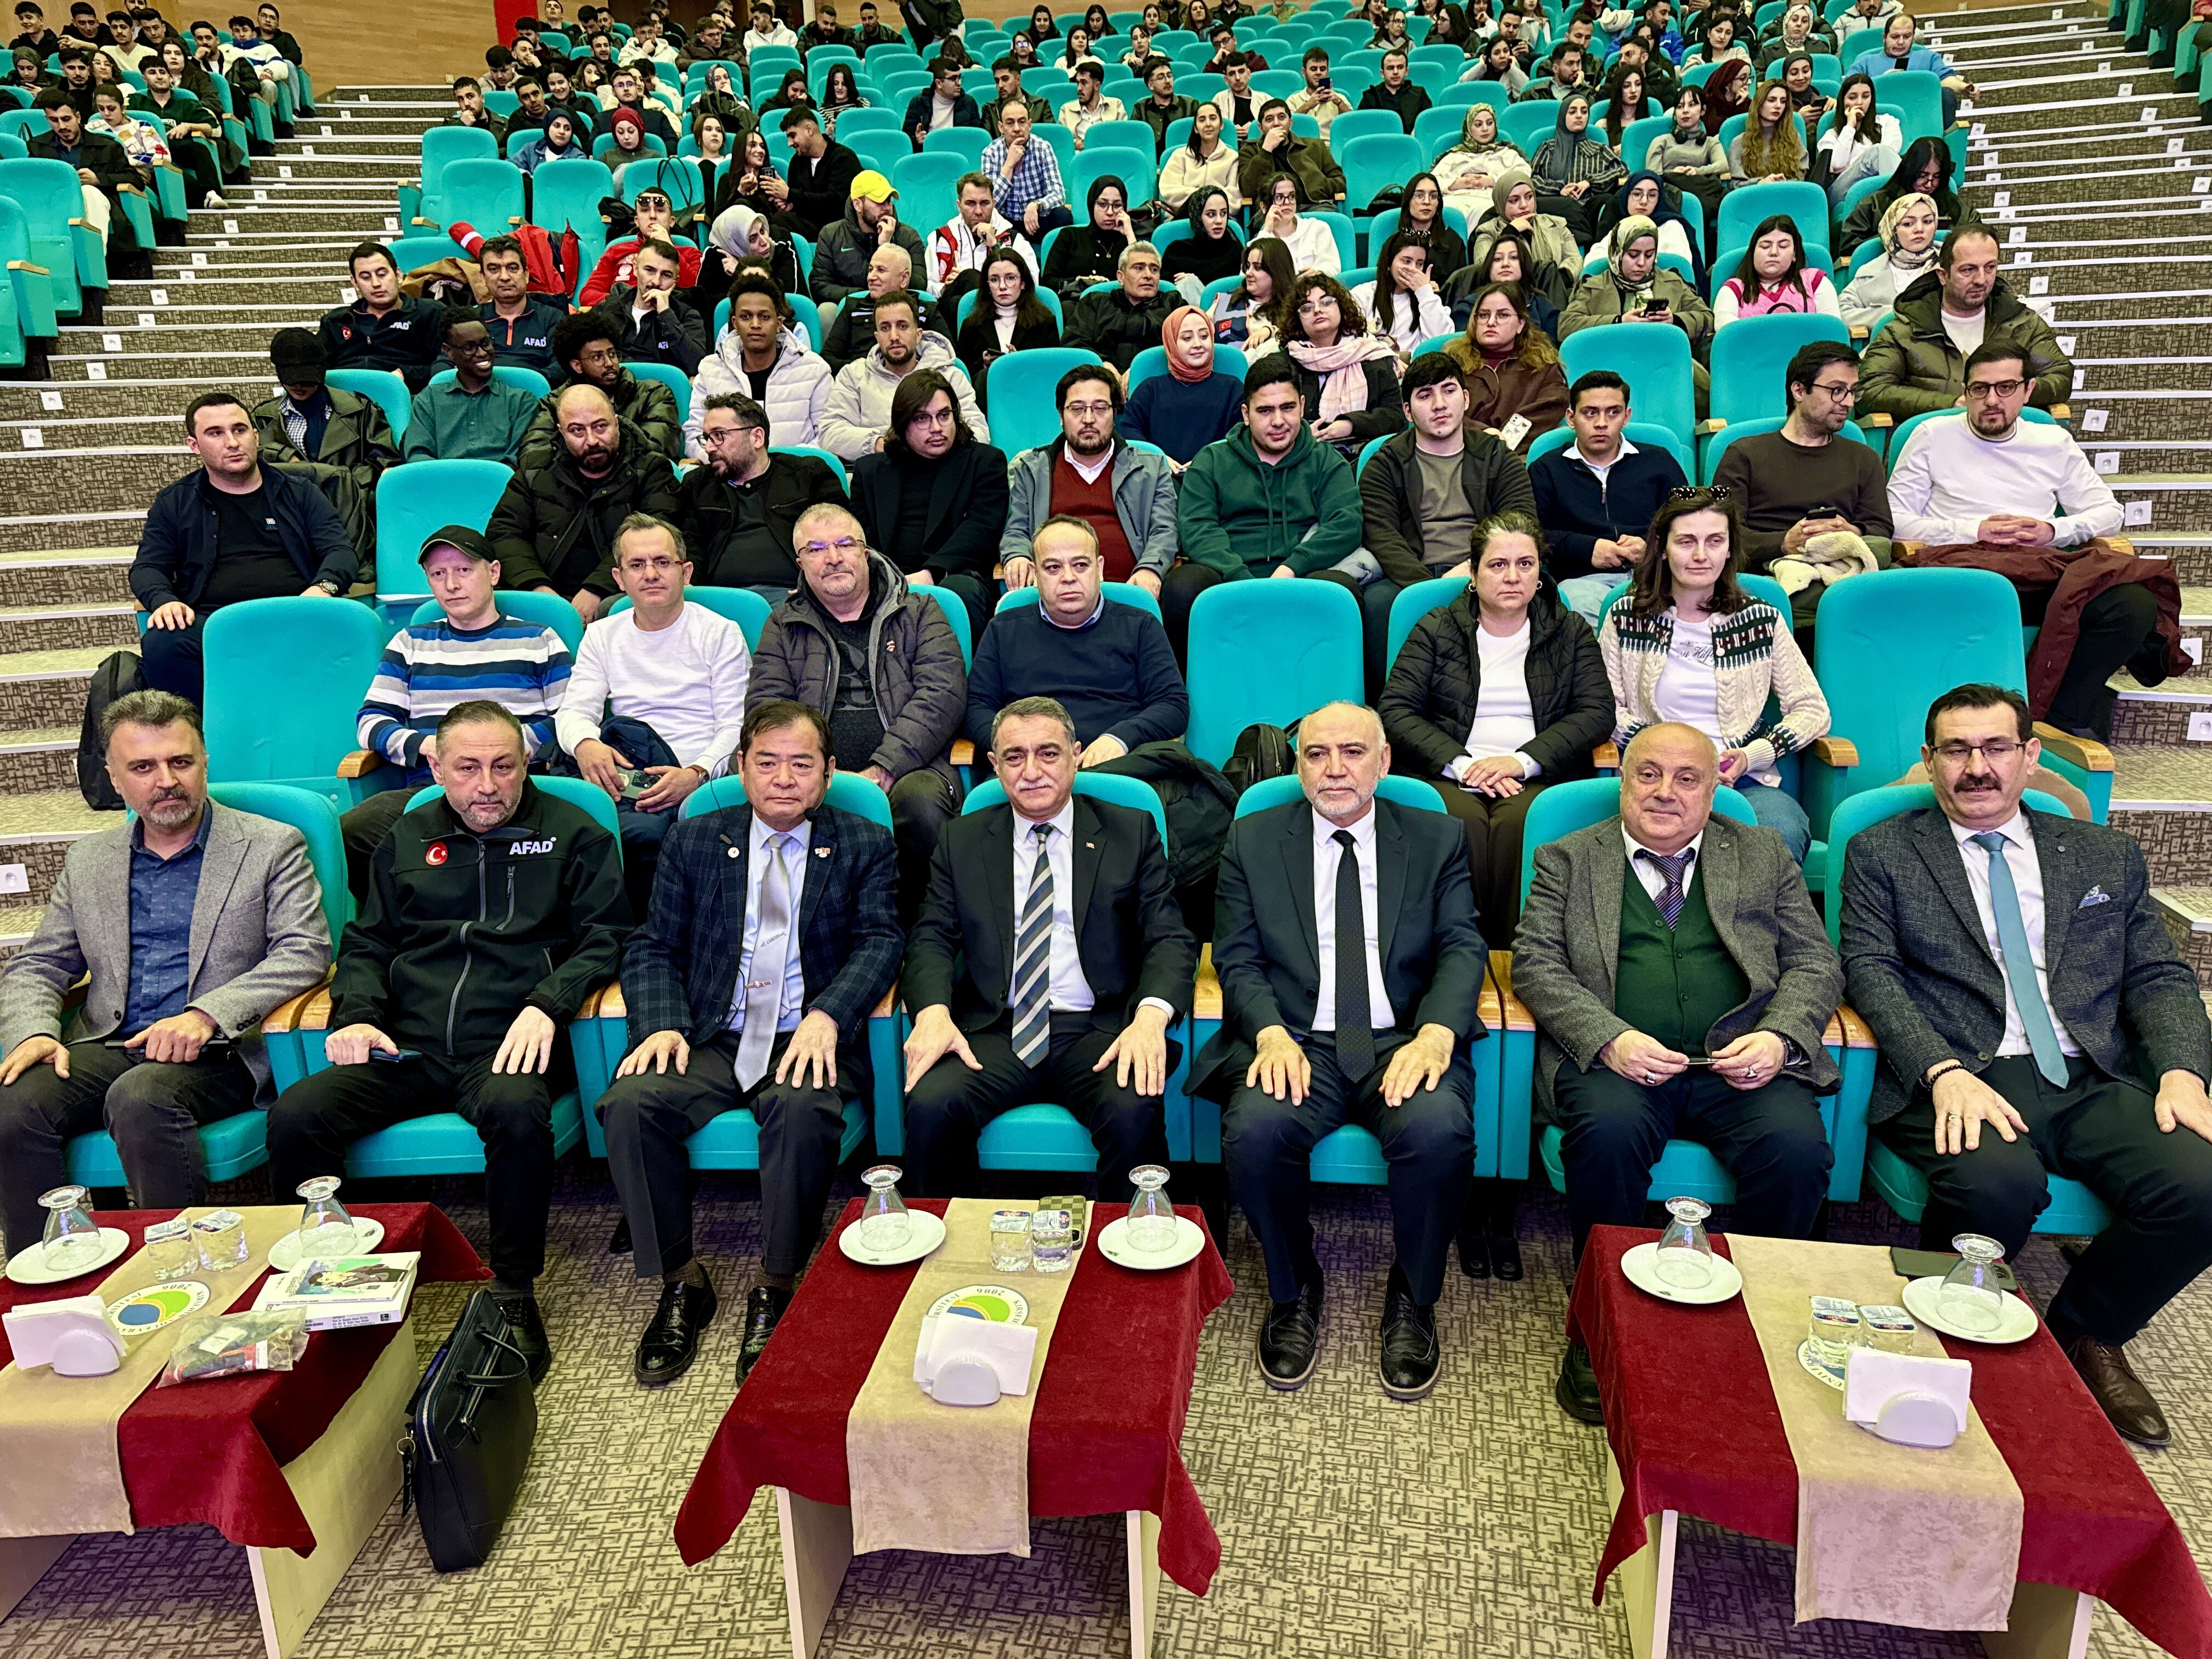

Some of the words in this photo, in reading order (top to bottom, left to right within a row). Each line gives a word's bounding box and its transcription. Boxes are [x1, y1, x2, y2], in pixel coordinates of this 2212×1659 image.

[524, 336, 546, 347] AFAD
[509, 837, 557, 855] AFAD
[977, 1288, 1006, 1296] 2006
